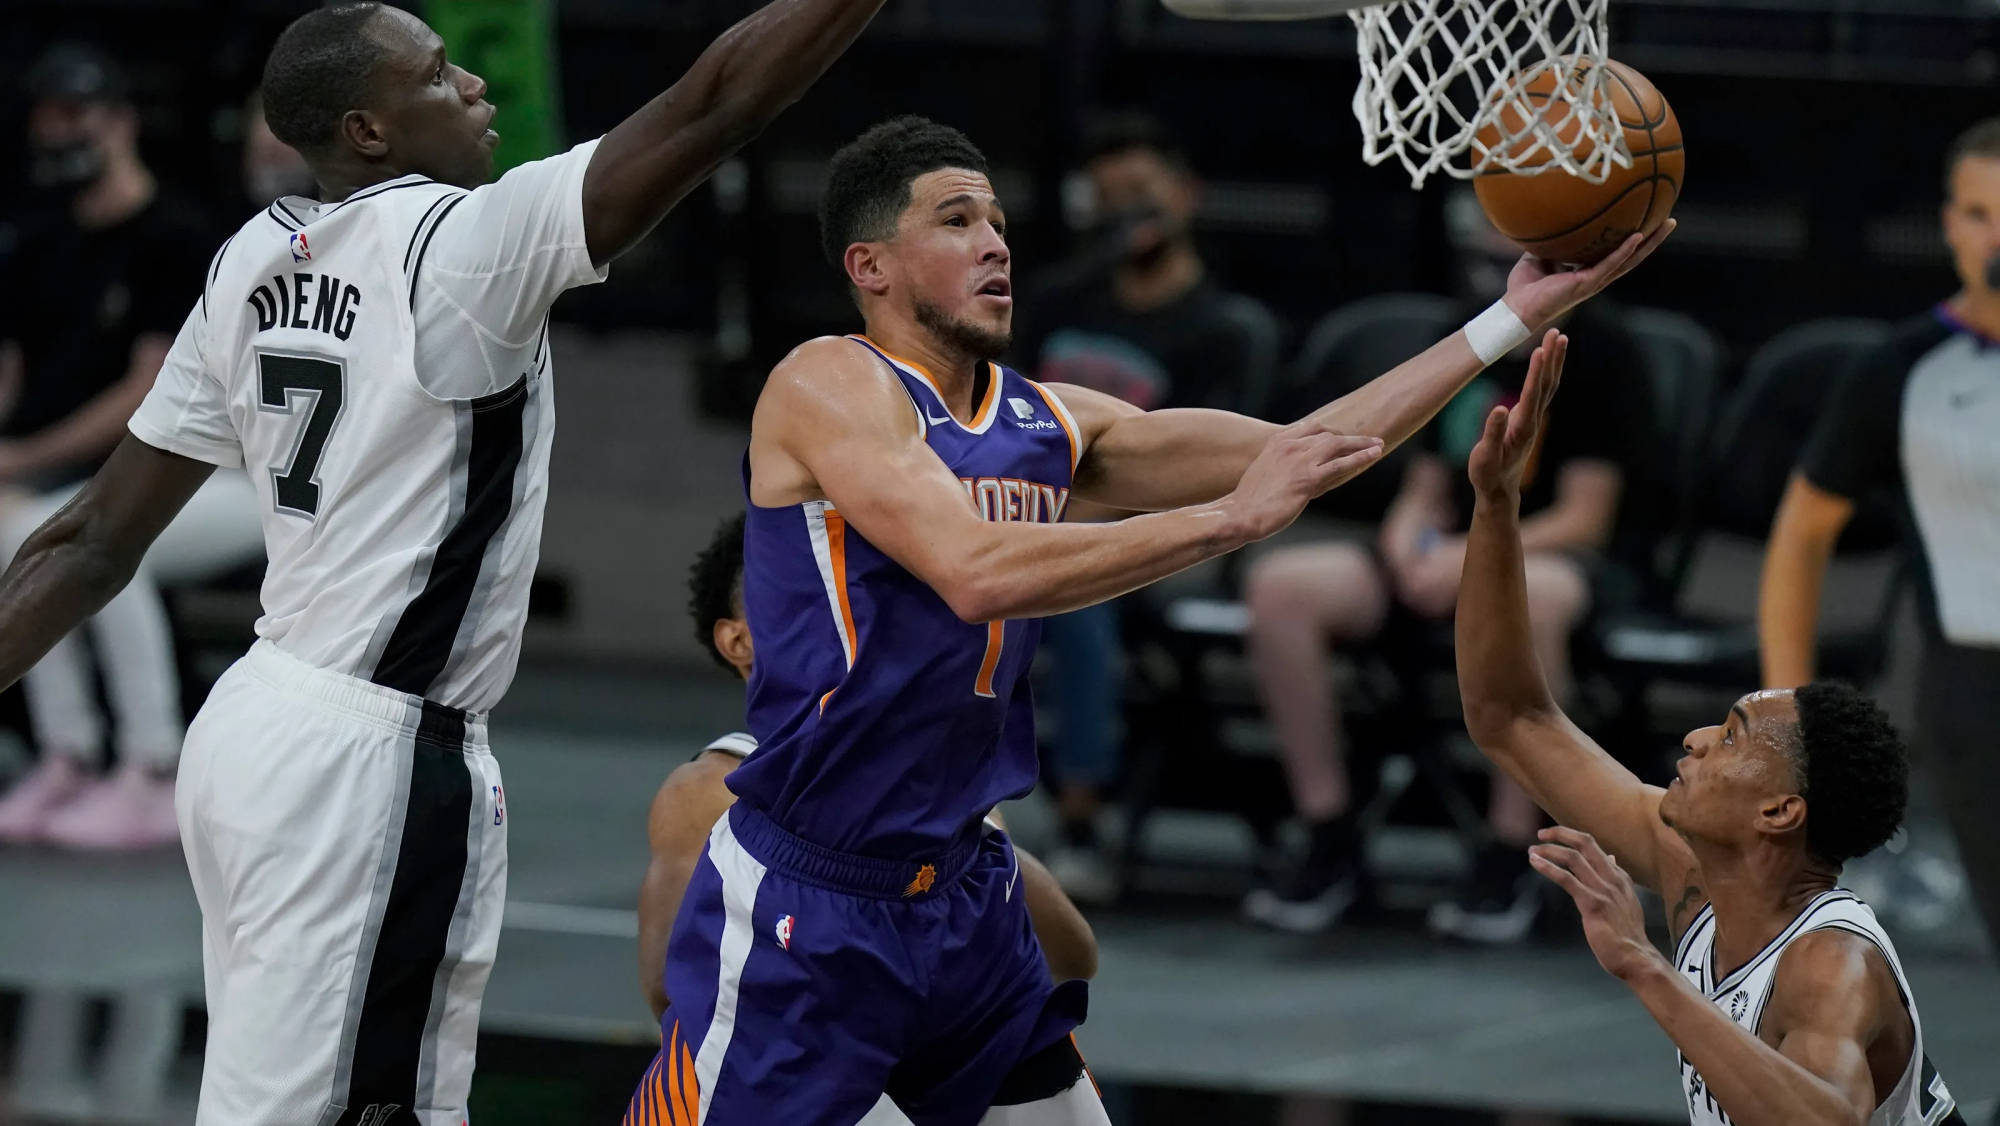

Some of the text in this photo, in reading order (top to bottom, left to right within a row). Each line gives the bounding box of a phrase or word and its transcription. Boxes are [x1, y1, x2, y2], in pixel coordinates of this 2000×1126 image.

[247, 273, 361, 342] DIENG
[254, 345, 348, 523] 7
[1016, 420, 1058, 431] PayPal
